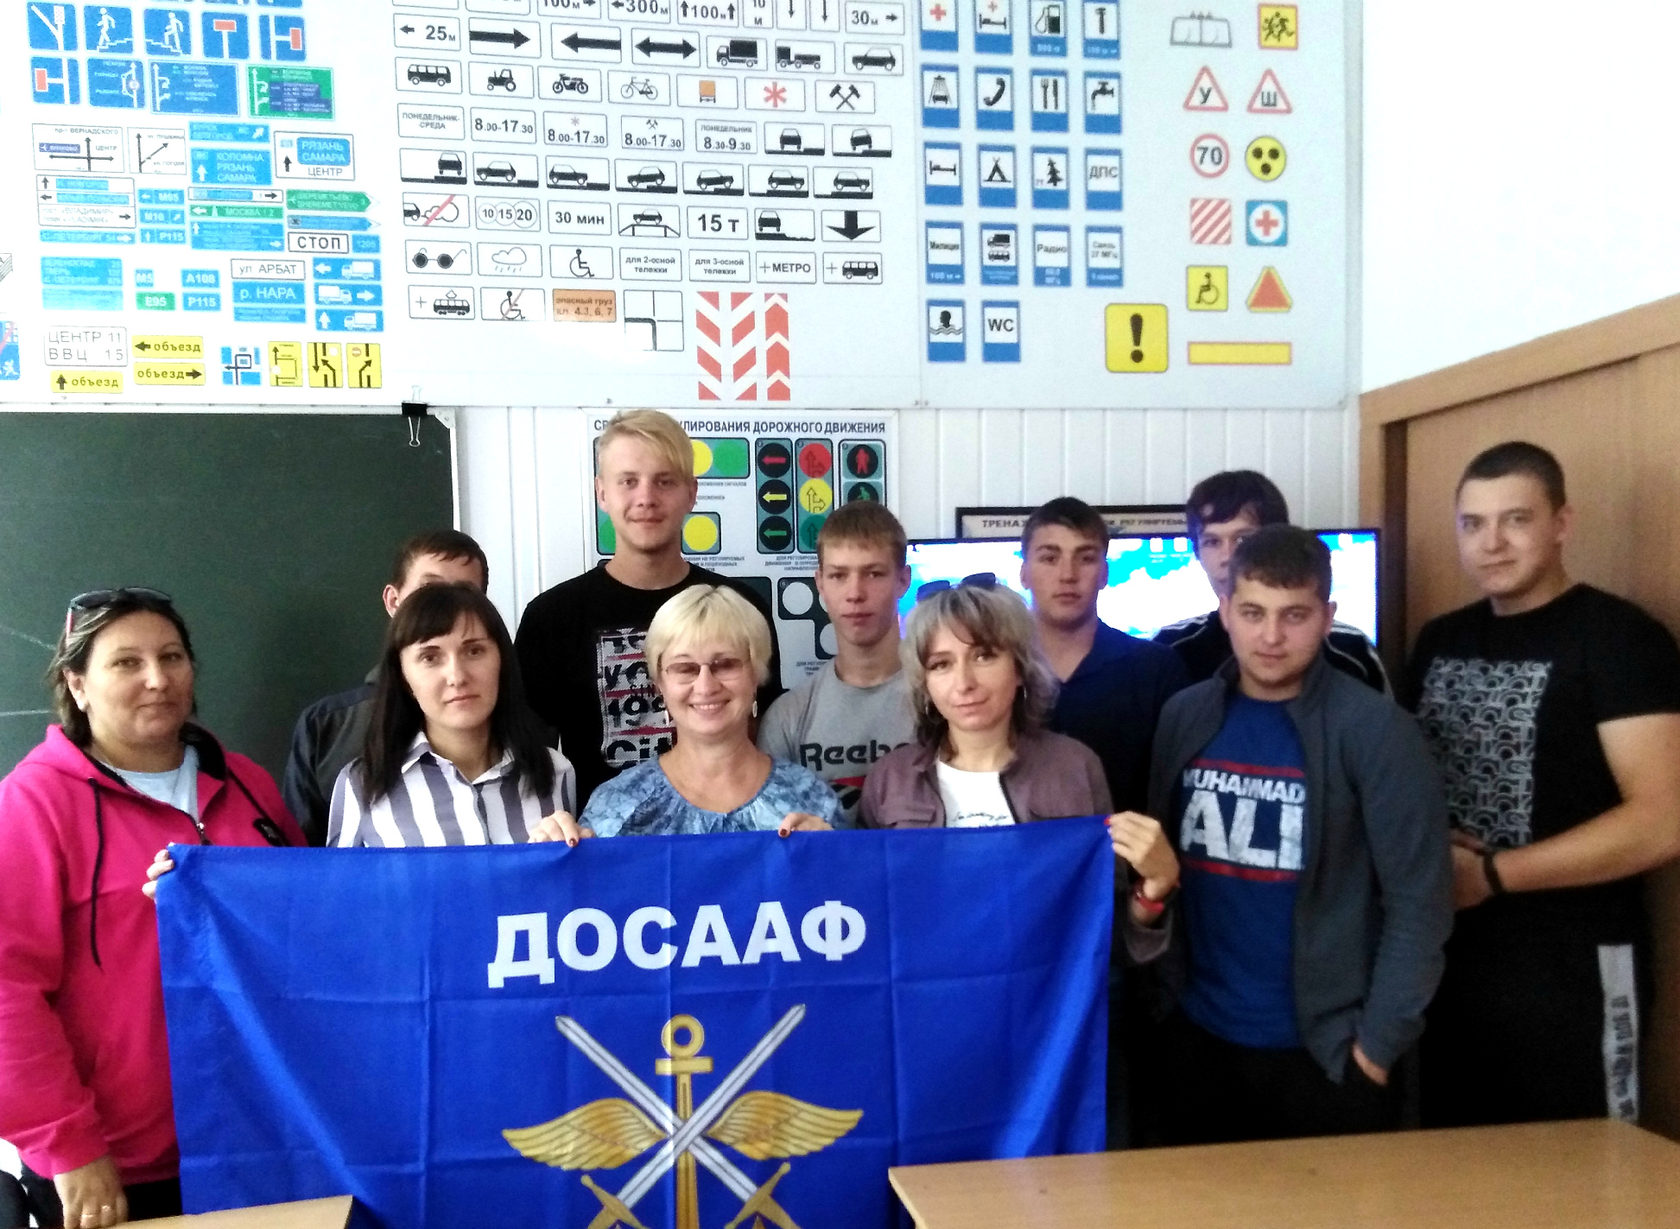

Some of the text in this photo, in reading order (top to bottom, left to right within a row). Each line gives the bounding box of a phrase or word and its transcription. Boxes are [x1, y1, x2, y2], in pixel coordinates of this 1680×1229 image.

[1260, 91, 1278, 107] Ш
[1196, 146, 1223, 166] 70
[307, 167, 343, 178] ЦЕНТР
[1088, 165, 1119, 180] ДПС
[481, 208, 533, 221] 10 15 20
[554, 210, 605, 226] 30 мин
[697, 213, 722, 233] 15
[297, 235, 341, 250] СТОП
[1036, 243, 1068, 255] Радио
[624, 256, 642, 266] для
[258, 263, 297, 275] АРБАТ
[634, 265, 668, 274] тележки
[703, 267, 737, 276] тележки
[256, 286, 297, 300] НАРА
[594, 298, 613, 307] груз
[987, 318, 1015, 333] WC
[48, 331, 101, 344] ЦЕНТР
[153, 341, 201, 352] объезд
[105, 348, 124, 361] 15
[136, 368, 184, 379] объезд
[71, 376, 119, 388] объезд
[752, 420, 823, 434] ДОРОЖНОГО
[823, 421, 886, 434] ДВИЖЕНИЯ
[1182, 768, 1307, 803] MUHAMMAD
[1180, 788, 1304, 870] ALI
[487, 900, 867, 988] ДОСААФ
